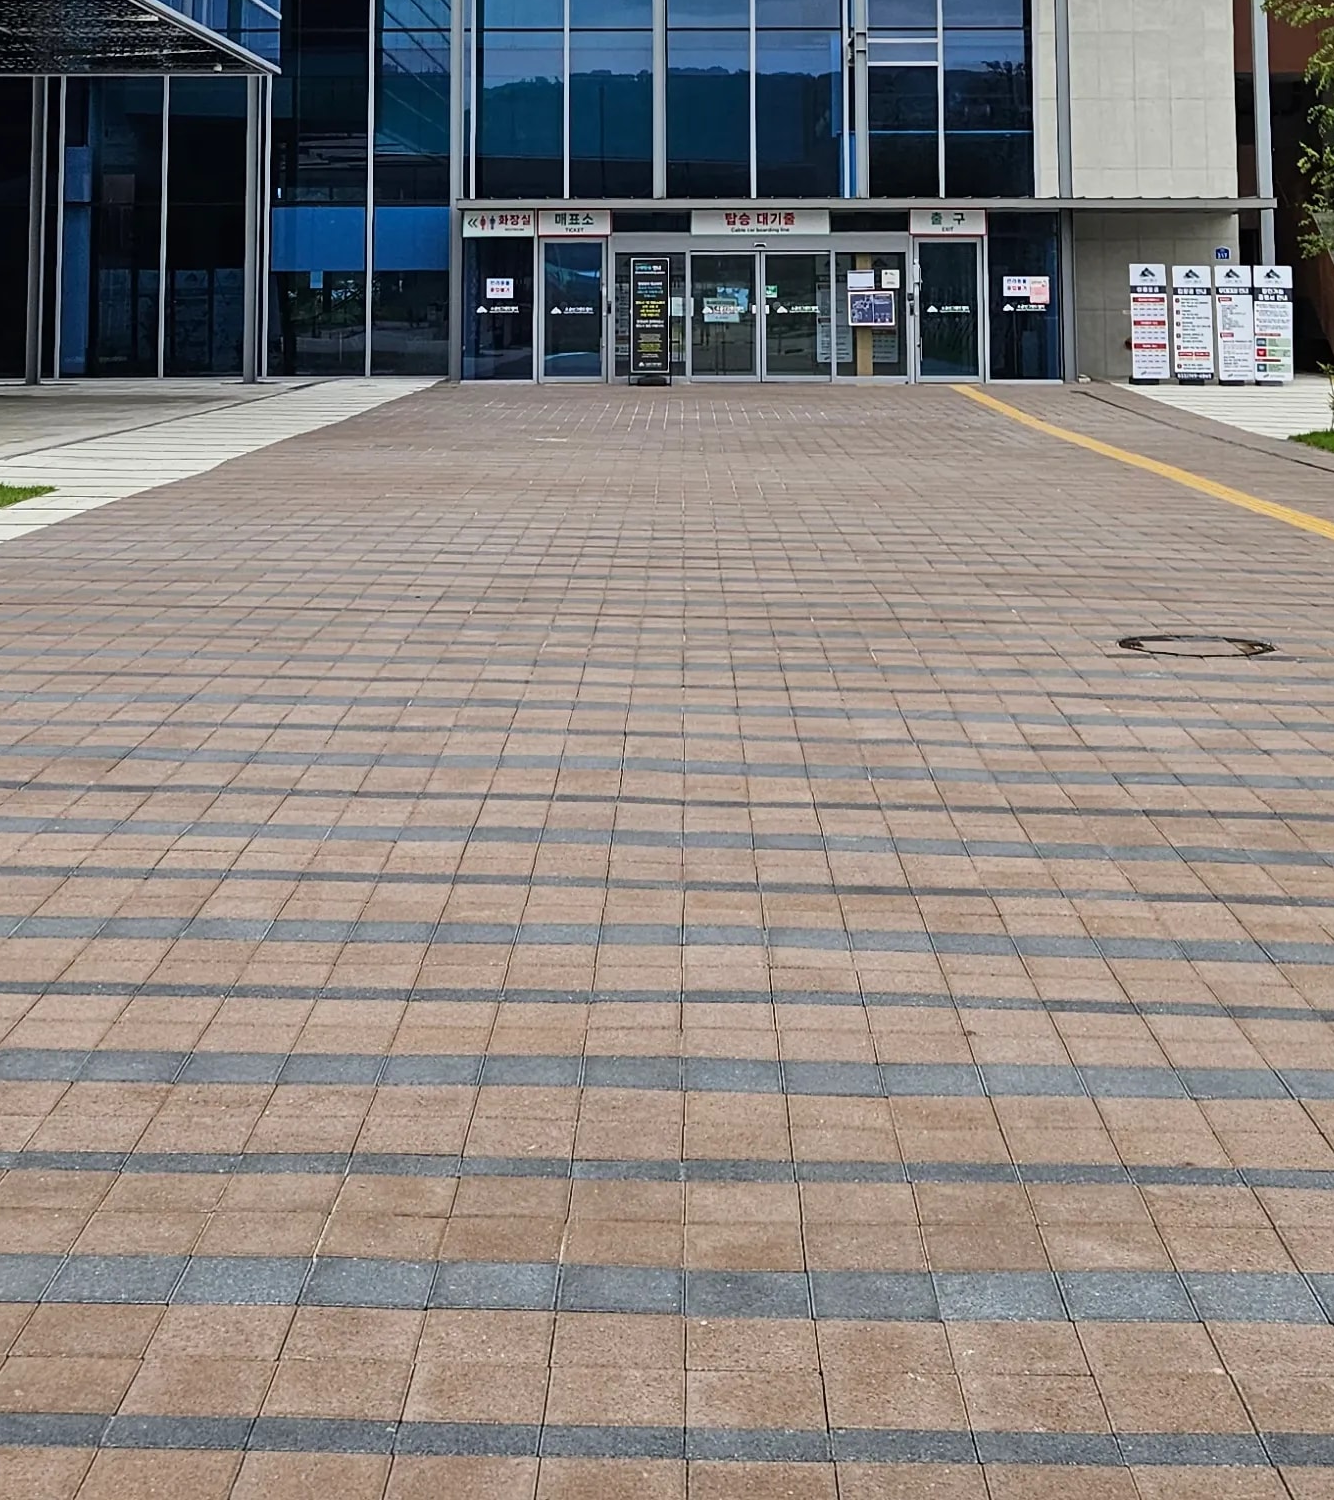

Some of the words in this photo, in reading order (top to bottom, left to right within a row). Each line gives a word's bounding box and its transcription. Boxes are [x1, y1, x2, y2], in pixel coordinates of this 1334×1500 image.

[498, 214, 531, 226] 화장실
[554, 212, 594, 226] 매표소
[725, 212, 751, 226] 탑승
[756, 212, 796, 226] 대기줄
